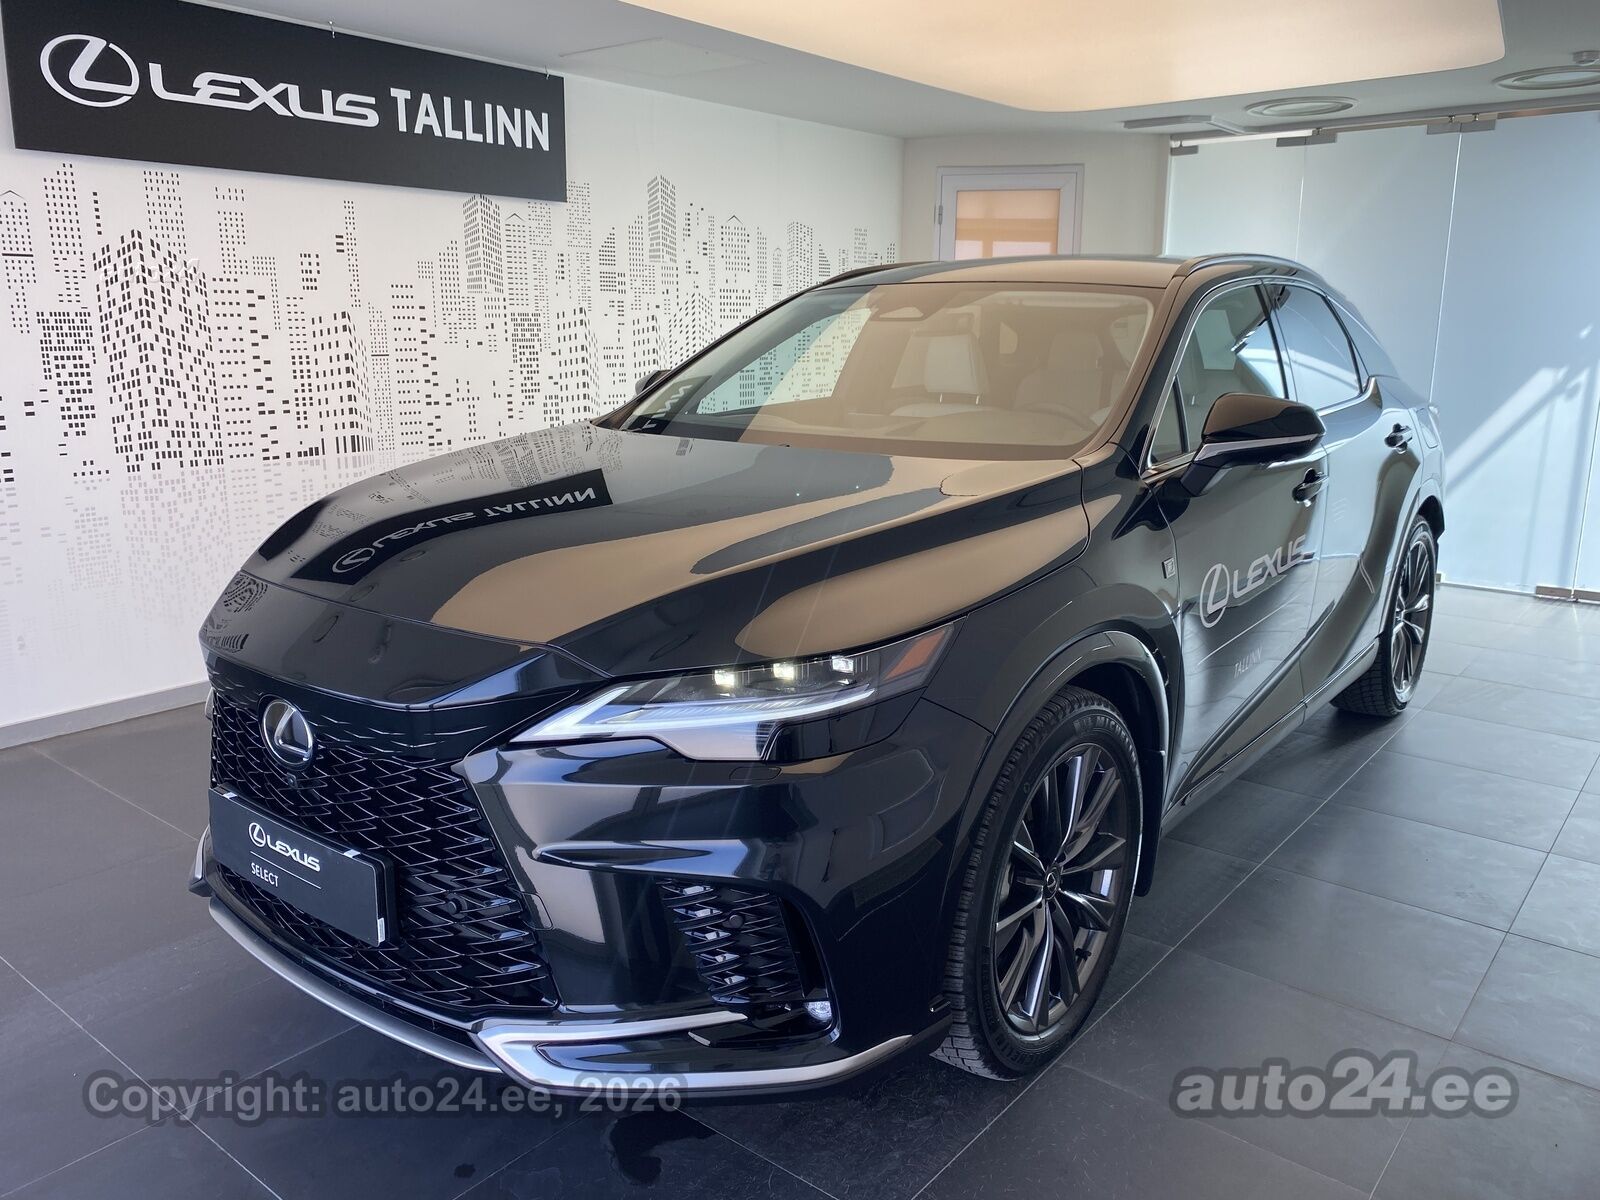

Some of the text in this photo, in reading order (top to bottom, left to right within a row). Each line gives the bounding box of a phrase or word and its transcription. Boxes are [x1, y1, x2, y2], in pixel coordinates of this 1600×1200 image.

[149, 62, 550, 151] LEXUS TALLINN
[266, 834, 321, 872] LEXUS
[251, 862, 279, 888] SELECT
